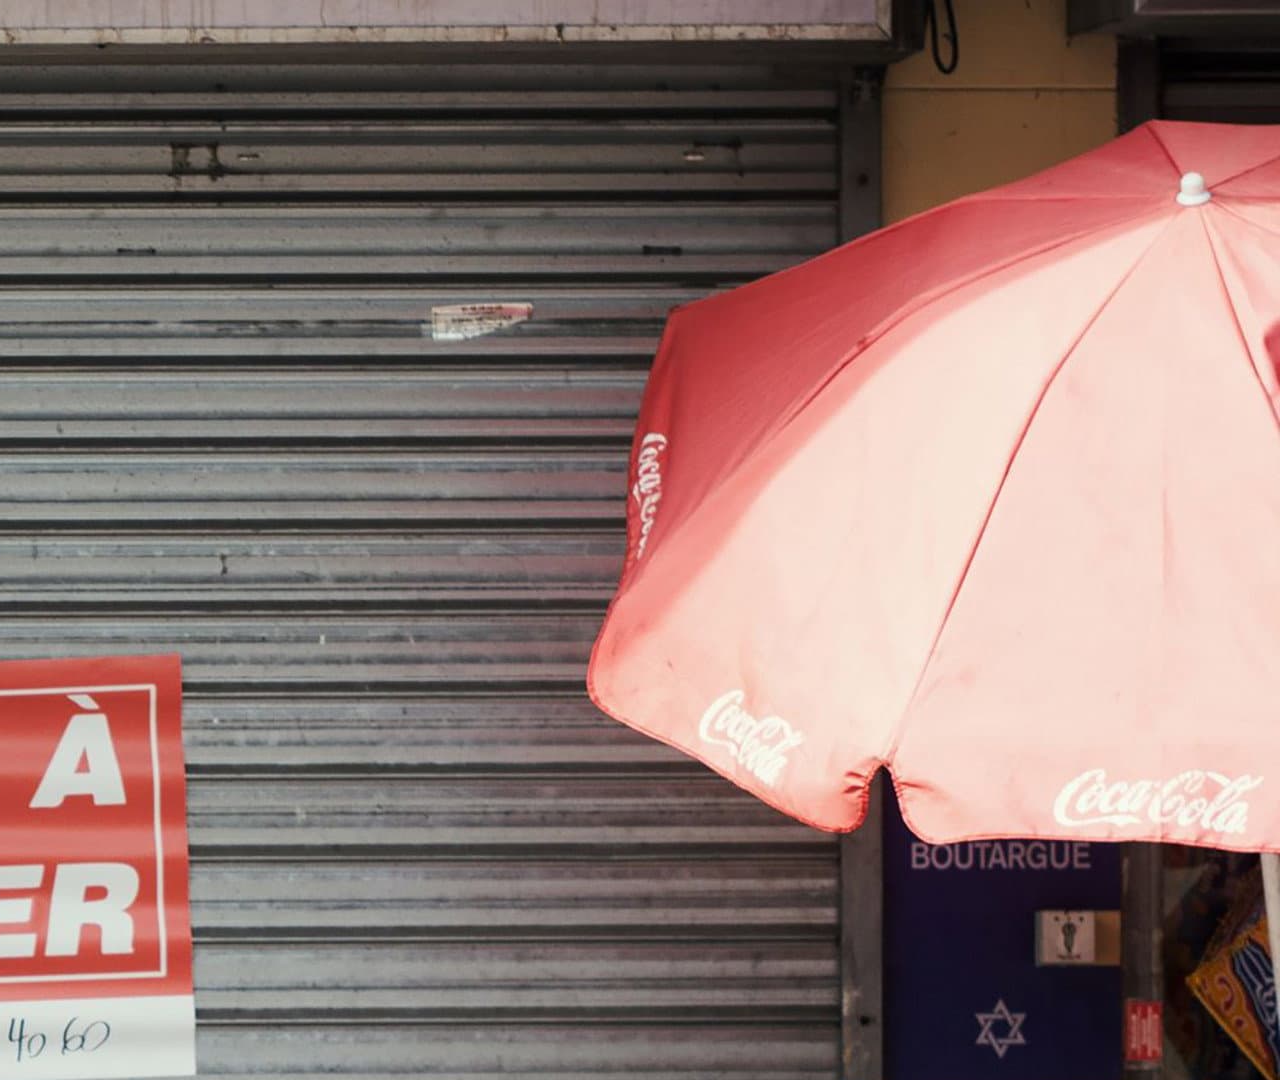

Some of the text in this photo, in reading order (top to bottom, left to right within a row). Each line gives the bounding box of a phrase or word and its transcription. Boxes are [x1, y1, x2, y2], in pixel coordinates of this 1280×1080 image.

[28, 694, 128, 809] À
[910, 842, 1092, 870] BOUTARGUE
[7, 1017, 47, 1063] 40
[61, 1016, 111, 1057] 60
